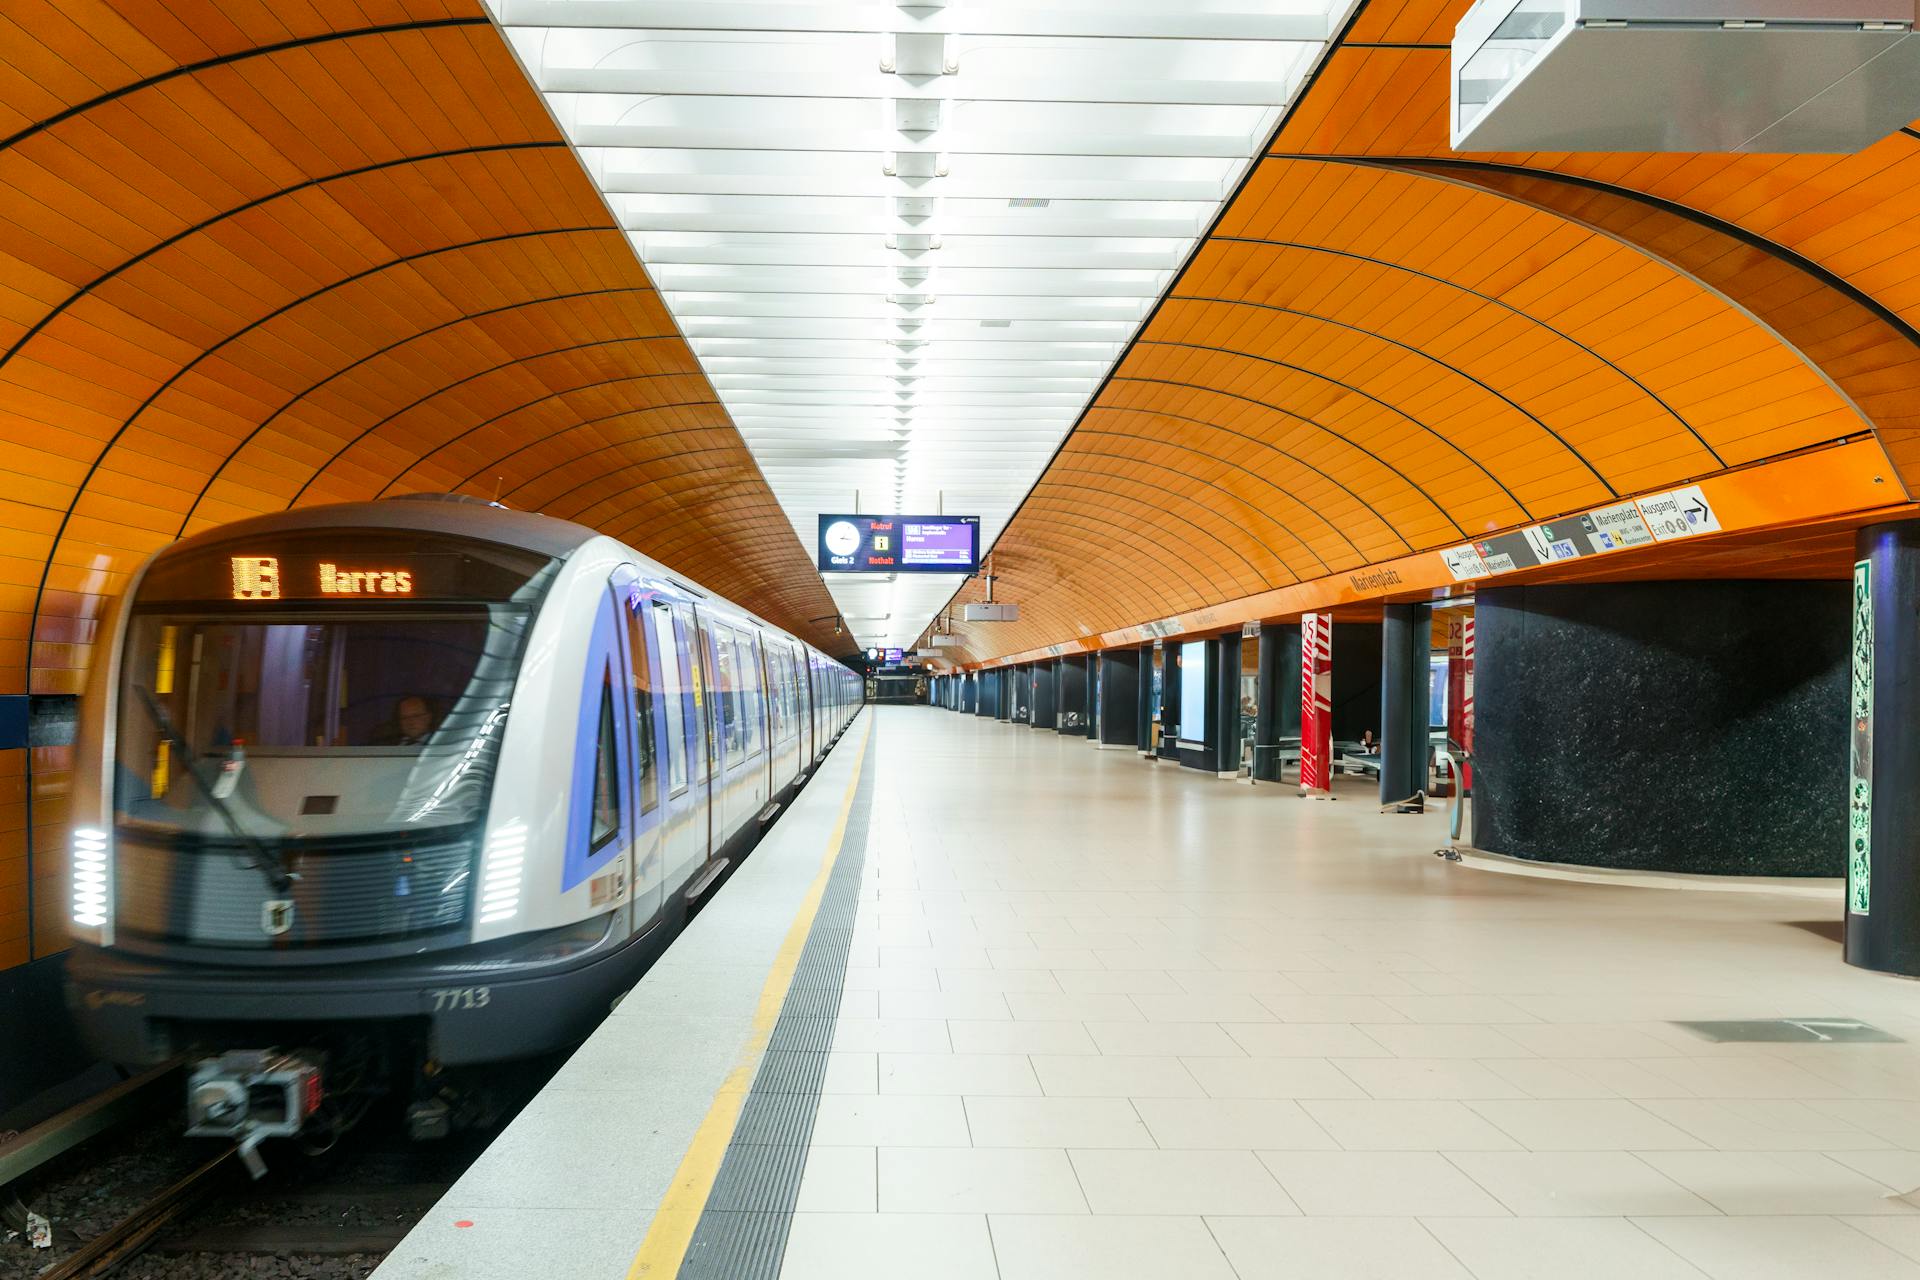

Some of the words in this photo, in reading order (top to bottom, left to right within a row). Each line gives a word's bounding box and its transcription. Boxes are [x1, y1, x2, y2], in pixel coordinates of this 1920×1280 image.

[1640, 500, 1678, 515] Ausgang
[1595, 508, 1640, 526] Marienplatz
[1543, 526, 1554, 539] S
[1651, 522, 1668, 536] Exit
[831, 556, 848, 564] Gleis
[848, 556, 855, 564] 2
[1456, 549, 1479, 560] Ausgang
[1348, 568, 1403, 592] Marienplatz
[431, 986, 491, 1012] 7713
